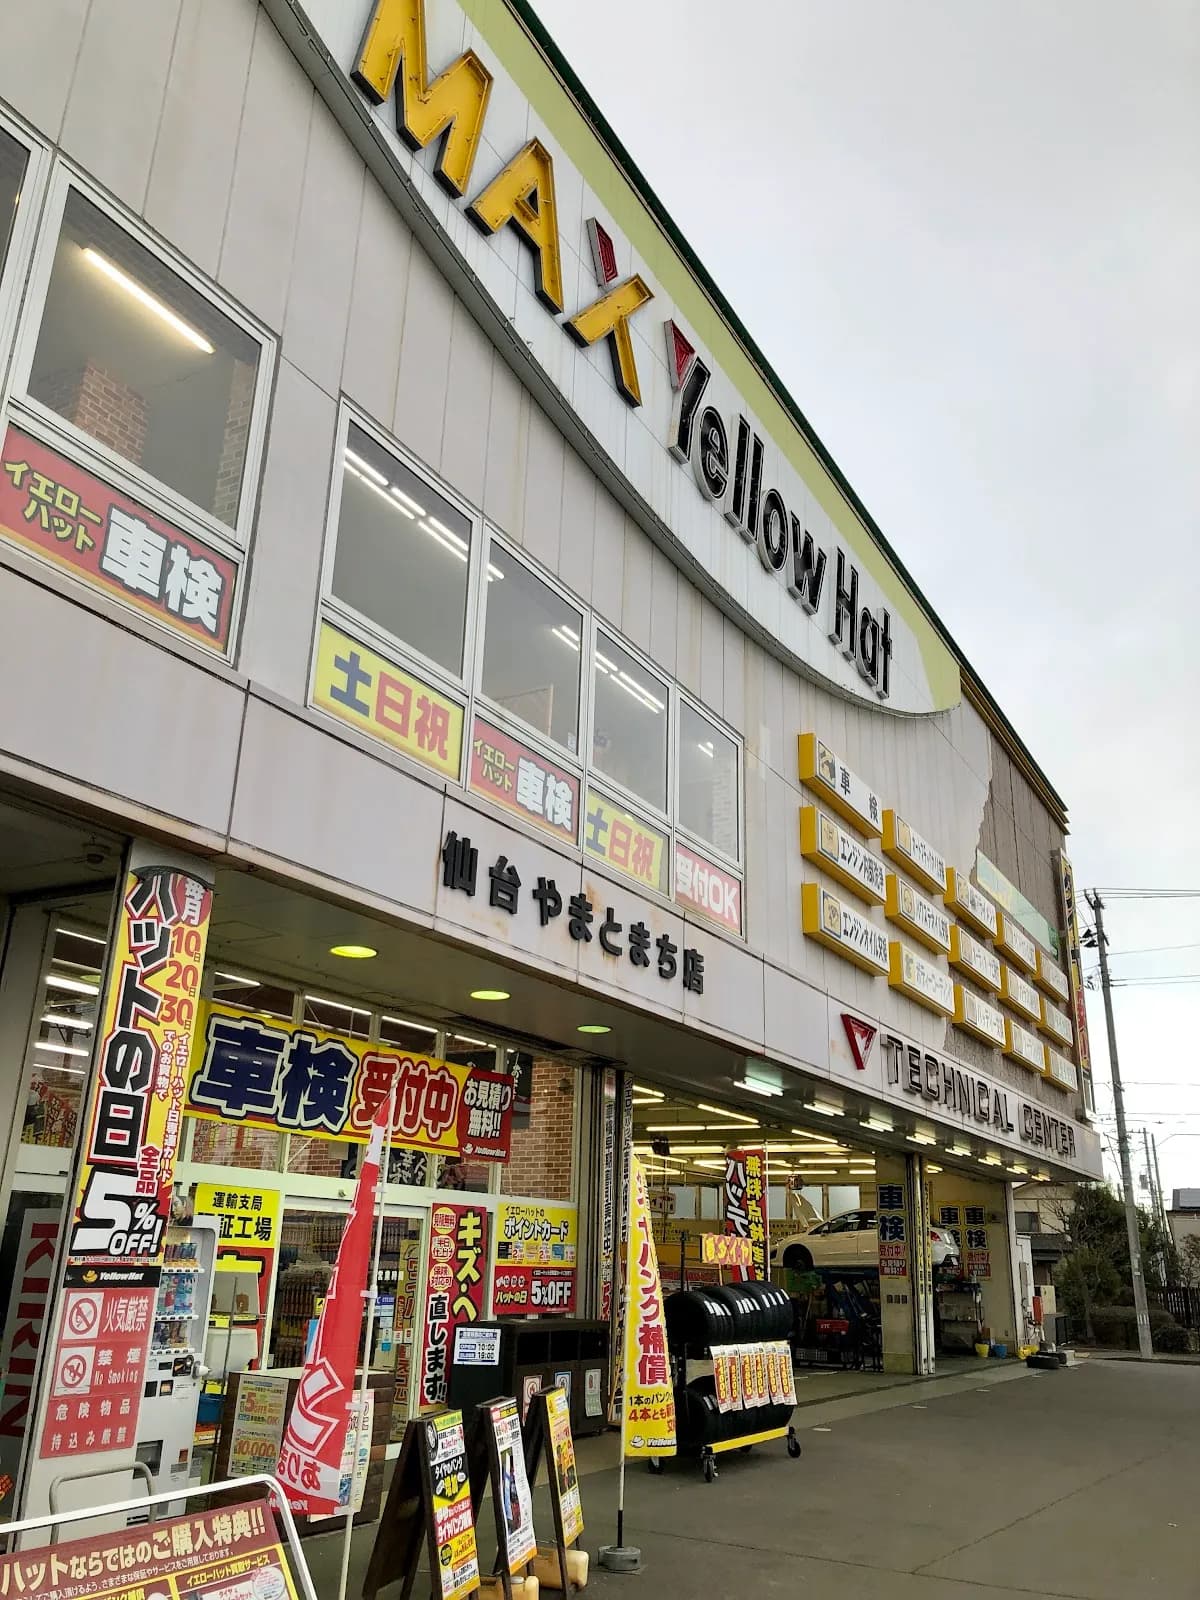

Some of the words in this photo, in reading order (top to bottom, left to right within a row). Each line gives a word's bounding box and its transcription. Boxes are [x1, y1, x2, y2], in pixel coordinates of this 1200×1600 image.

[352, 0, 655, 407] MAX
[4, 461, 103, 526] イエロー
[665, 319, 826, 616] Yellow
[828, 545, 894, 700] Hat
[24, 498, 95, 552] ハット
[101, 506, 226, 635] 車検
[330, 651, 451, 761] 土日祝
[474, 738, 515, 772] イエロー
[482, 760, 512, 793] ハット
[515, 757, 573, 832] 車検
[586, 807, 657, 881] 土日祝
[442, 831, 705, 995] 仙台やまとまち店
[676, 851, 738, 923] 受付OK
[89, 874, 178, 1162] ハットの日
[190, 1013, 358, 1135] 車検
[352, 1051, 459, 1141] 受付中
[463, 1076, 513, 1112] お見積り
[880, 1033, 1015, 1133] TECHNICAL
[1018, 1102, 1077, 1158] CENTER
[136, 1145, 161, 1197] 全品
[212, 1191, 263, 1212] 運輸支局
[109, 1218, 163, 1255] OFF!
[198, 1213, 273, 1242] 証工場
[504, 1217, 569, 1241] ポイントカード
[878, 1184, 906, 1242] 車検
[964, 1205, 987, 1249] 車検
[0, 1223, 59, 1436] KIRIN
[102, 1296, 149, 1334] 火気厳禁
[94, 1370, 104, 1387] No
[55, 1398, 131, 1422] 危険物品
